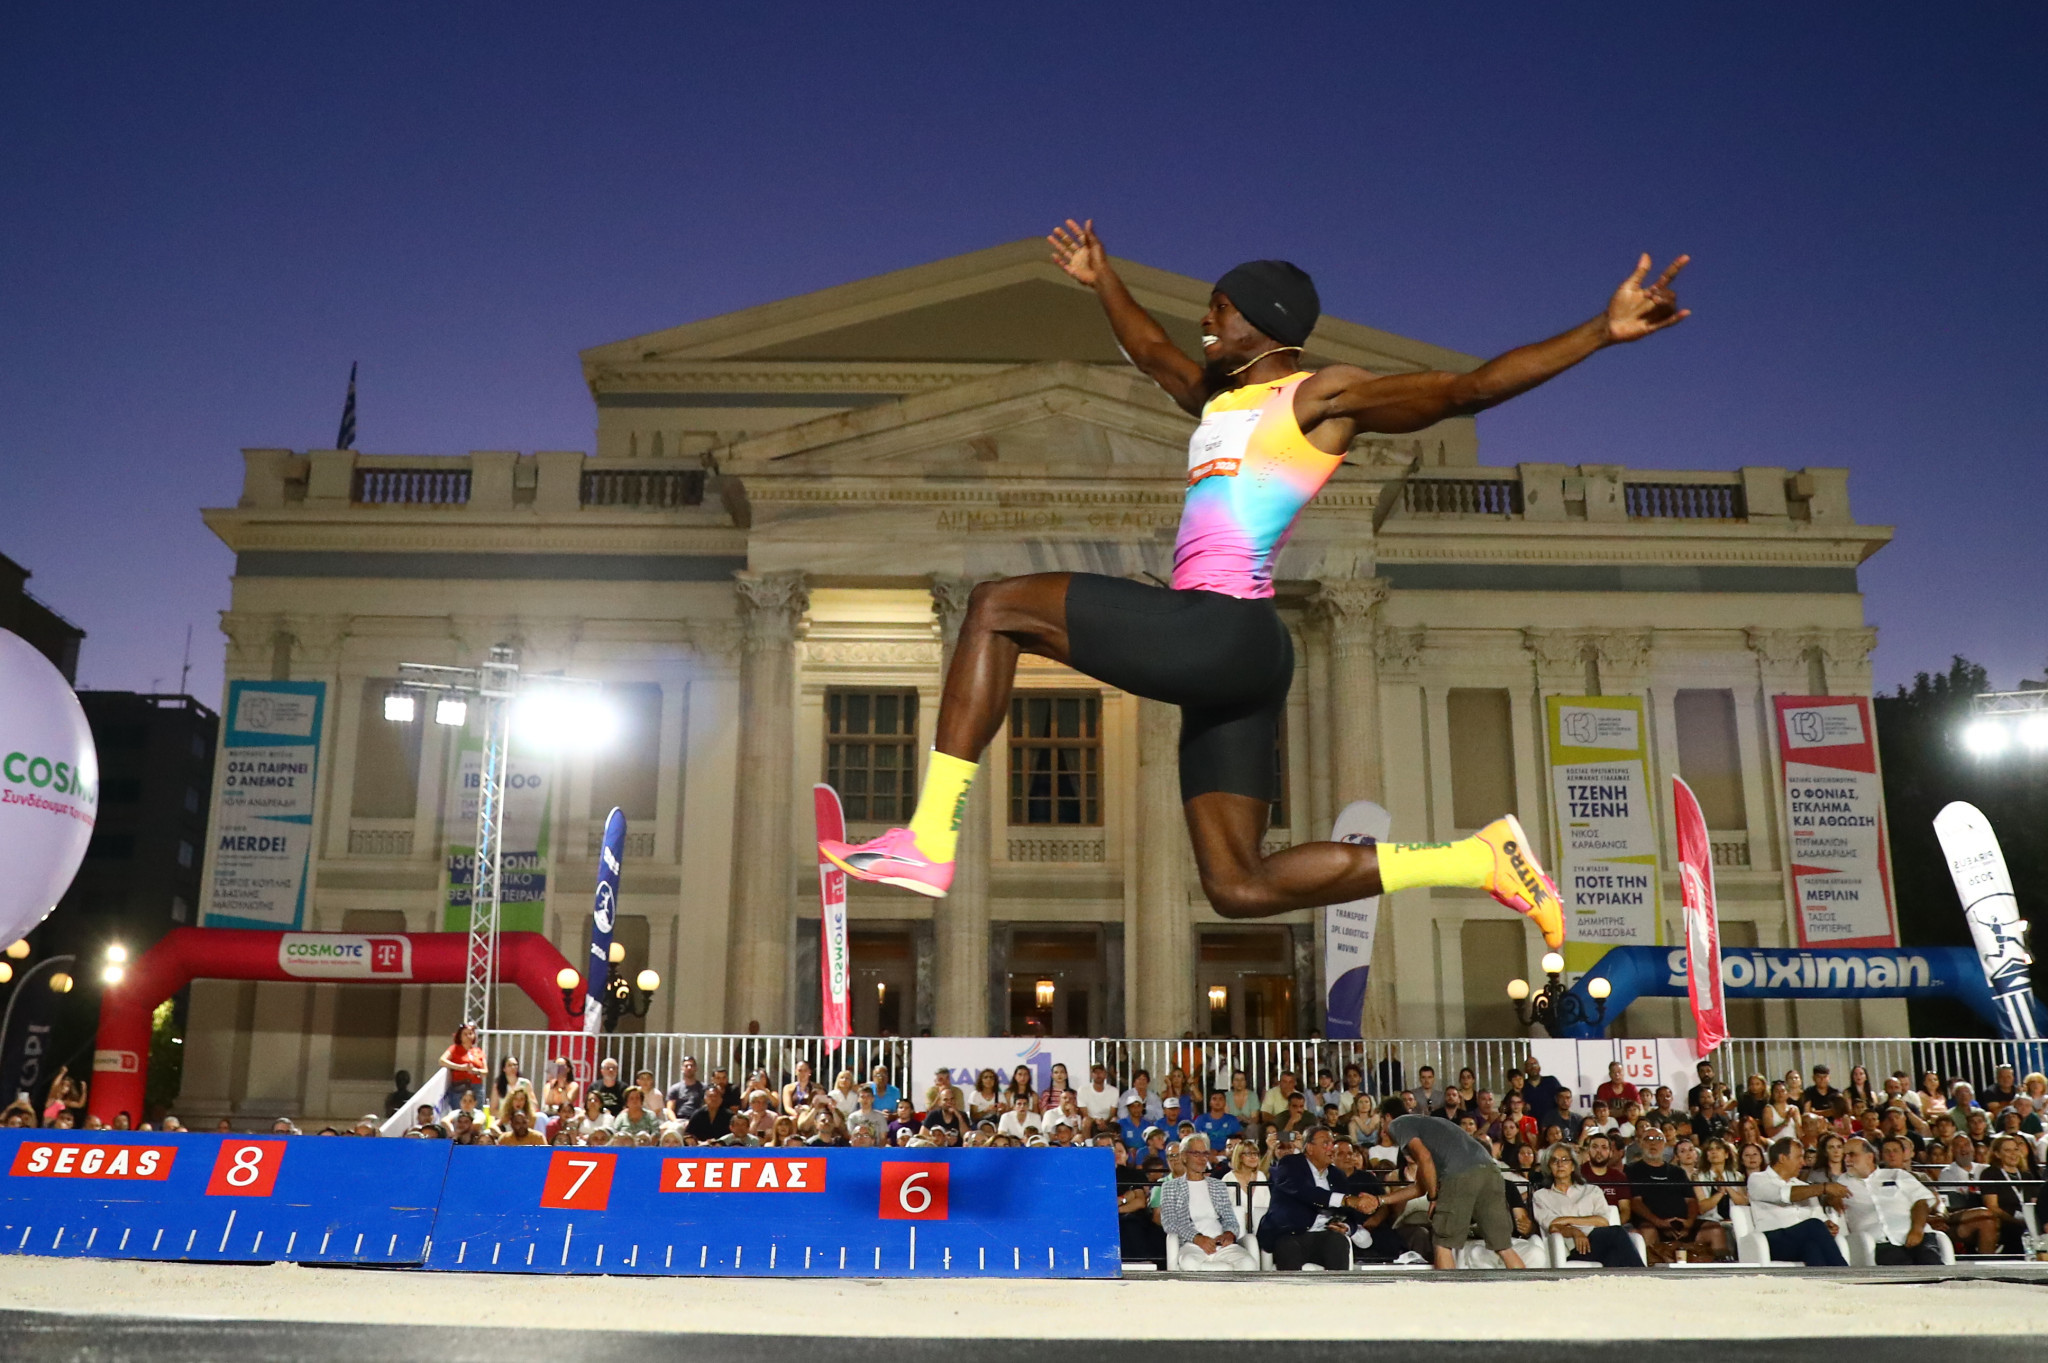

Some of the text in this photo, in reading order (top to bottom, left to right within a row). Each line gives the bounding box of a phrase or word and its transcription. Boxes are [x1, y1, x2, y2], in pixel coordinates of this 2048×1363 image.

[228, 762, 308, 774] ΟΣΑ ΠΑΙΡΝΕΙ
[226, 776, 295, 787] Ο ΑΝΕΜΟΣ
[464, 773, 541, 788] ΙΒΟΦ
[1568, 785, 1627, 800] ΤΖΕΝΗ
[1791, 788, 1859, 800] Ο ΦΟΝΙΑΣ,
[1569, 803, 1629, 817] ΤΖΕΝΗ
[1792, 802, 1852, 813] ΕΓΚΛΗΜΑ
[1793, 816, 1875, 827] ΚΑΙ ΑΘΩΩΣΗ
[1571, 829, 1599, 838] ΝΙΚΟΣ
[220, 836, 286, 852] MERDE!
[1572, 840, 1628, 849] ΚΑΡΑΘΑΝΟΣ
[1503, 841, 1550, 909] NITRO
[1575, 876, 1647, 888] ΠΟΤΕ ΤΗΝ
[1576, 893, 1643, 905] ΚΥΡΙΑΚΗ
[1807, 890, 1859, 901] ΜΕΡΙΛΙΝ
[1336, 909, 1368, 921] TRANSPORT
[1808, 913, 1836, 921] ΤΑΣΟΣ
[1577, 917, 1625, 926] ΔΗΜΗΤΡΗΣ
[1342, 926, 1369, 939] LOGISTICS
[1579, 928, 1637, 937] ΜΑΛΙΣΣΟΒΑΣ
[287, 944, 363, 957] COSMOTE
[1337, 943, 1358, 954] MOVING
[1667, 950, 1930, 988] Soiximan
[27, 1146, 263, 1186] SEGAS 8
[563, 1160, 932, 1213] 7 ΣΕΓΑΣ 6
